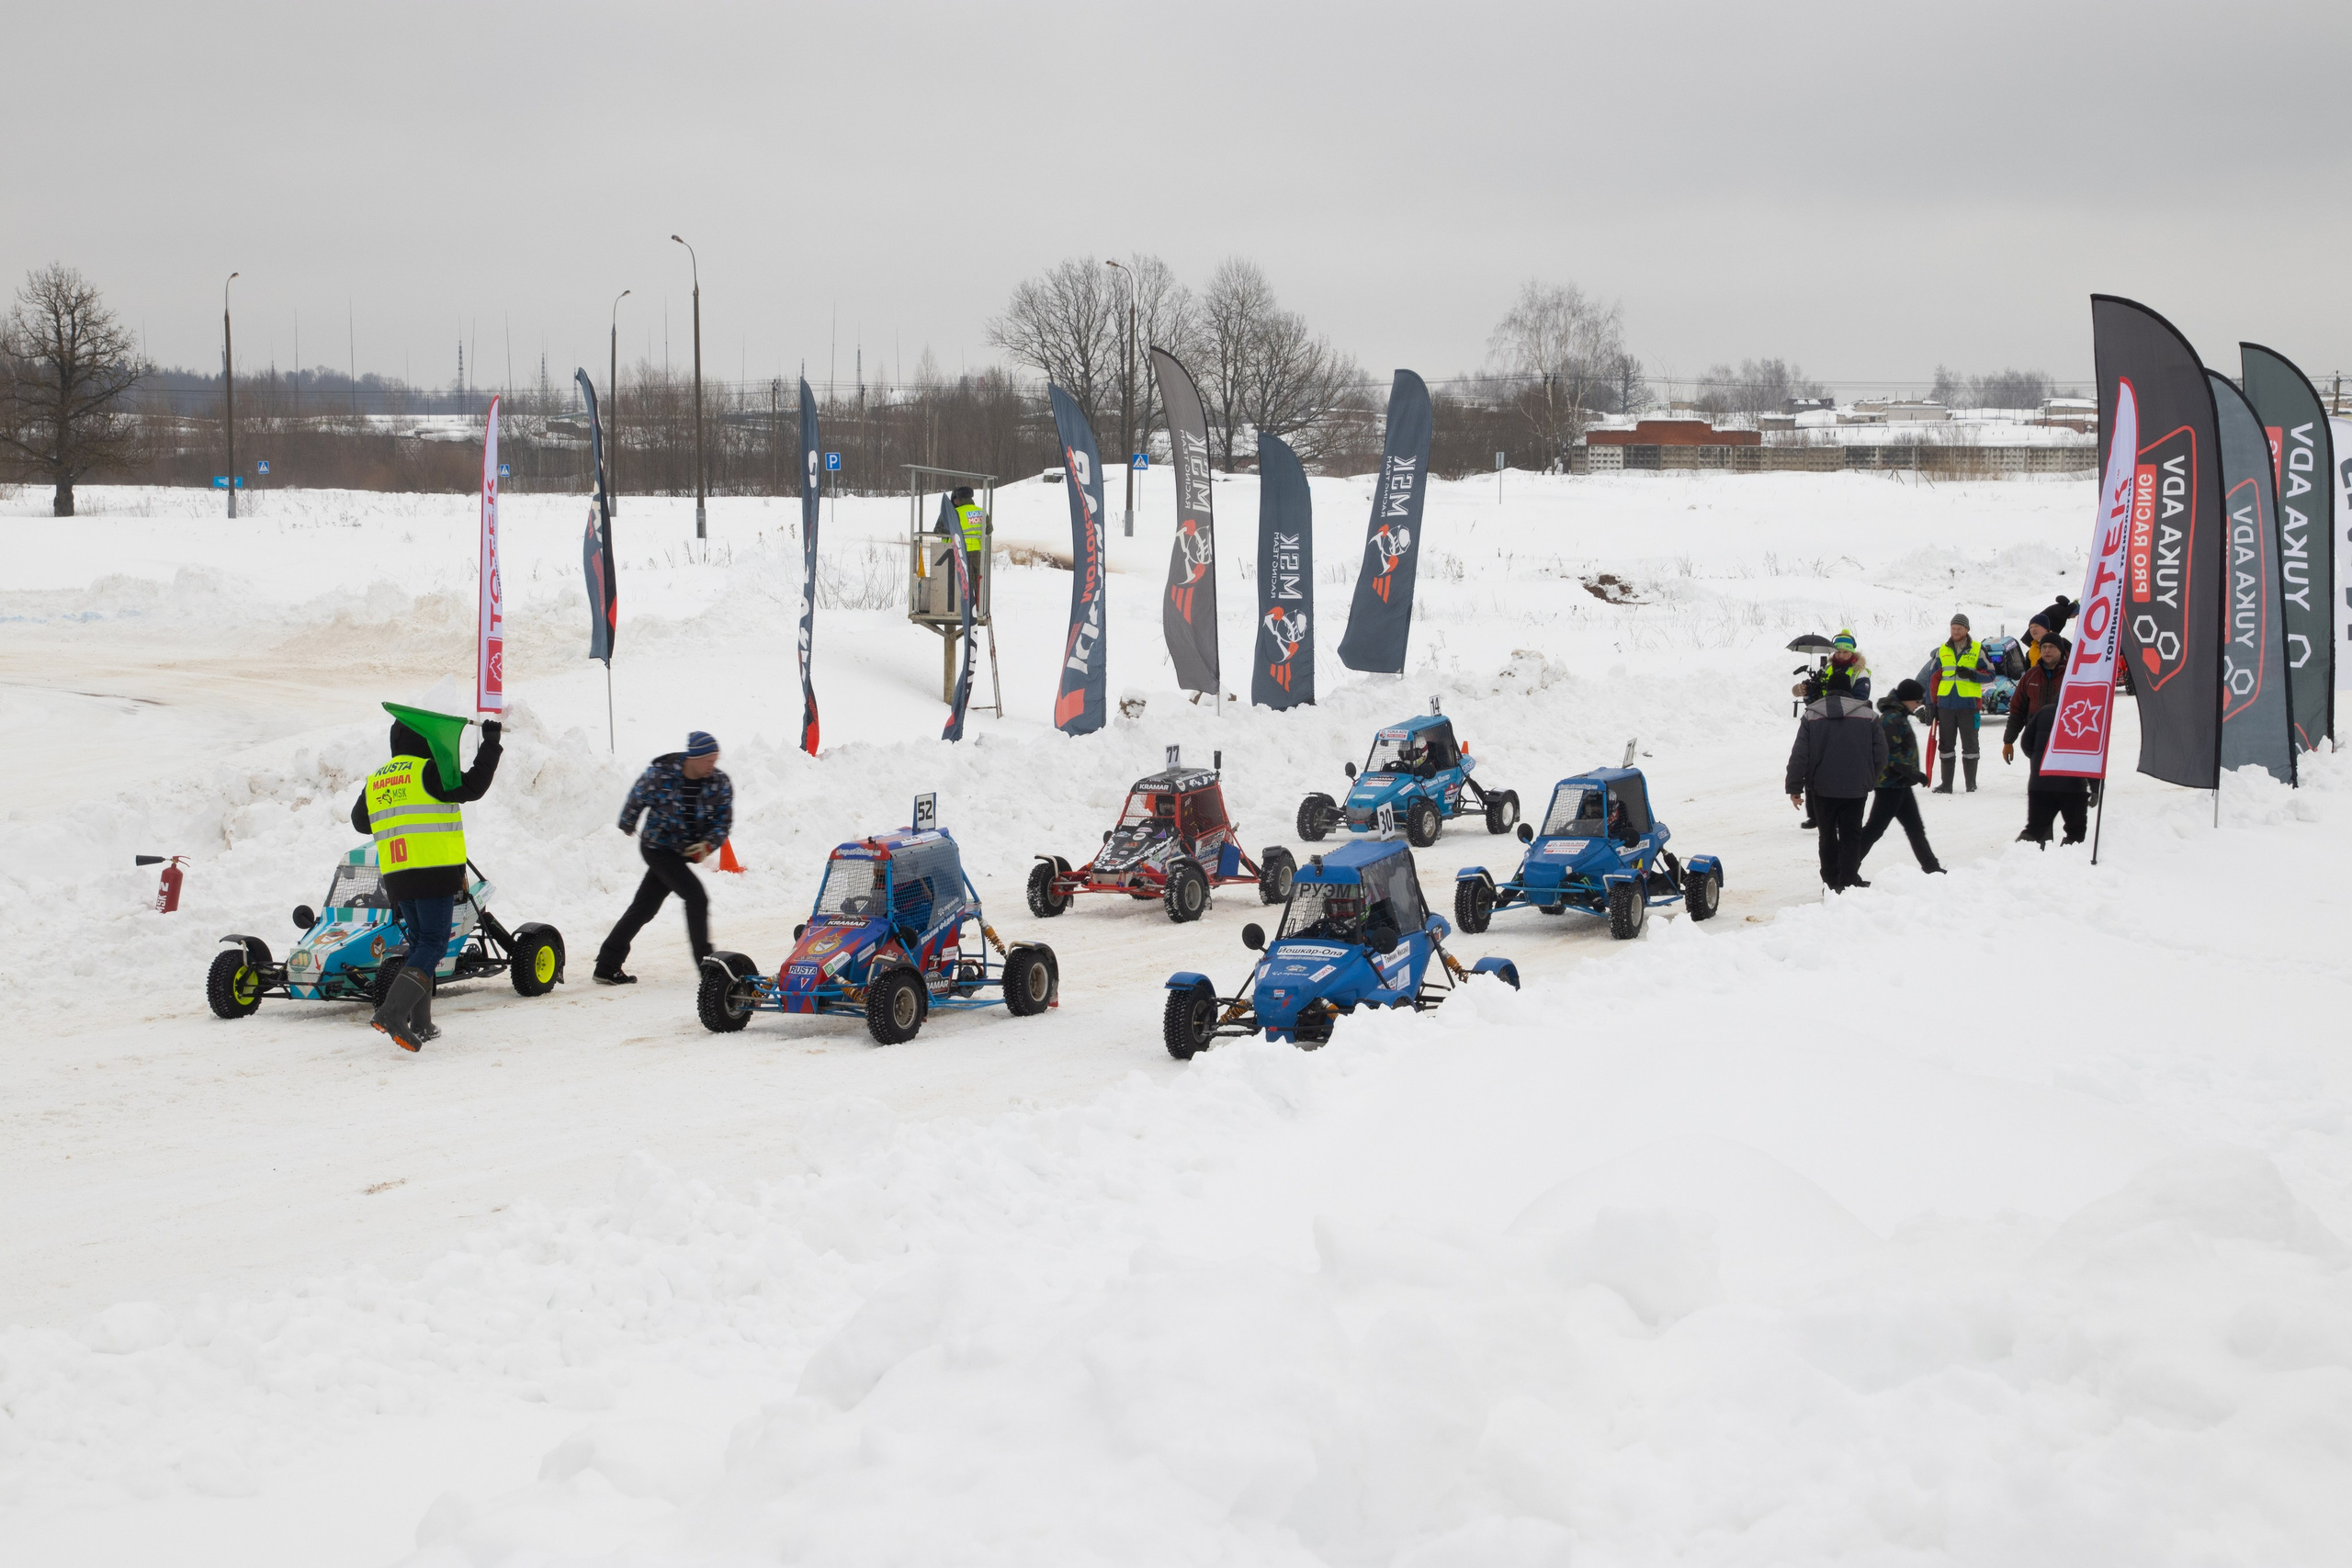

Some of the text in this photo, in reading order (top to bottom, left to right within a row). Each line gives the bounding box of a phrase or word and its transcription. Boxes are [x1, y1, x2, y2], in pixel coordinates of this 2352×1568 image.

[830, 455, 838, 468] P
[934, 548, 956, 613] 1
[2071, 475, 2129, 675] TOTEK
[2104, 578, 2123, 663] ТОПЛИВНЫЕ
[1430, 696, 1440, 715] 14
[1167, 745, 1180, 763] 77
[375, 761, 413, 778] RUSTA
[372, 774, 412, 791] МАРШАЛ
[392, 788, 407, 798] MSK
[917, 800, 933, 822] 52
[1379, 808, 1393, 835] 30
[390, 838, 408, 864] 10
[1299, 883, 1352, 898] РУЭМ
[1278, 946, 1346, 958] Йошкар-Ола
[790, 966, 818, 975] RUSTA
[925, 979, 949, 990] RAMAR
